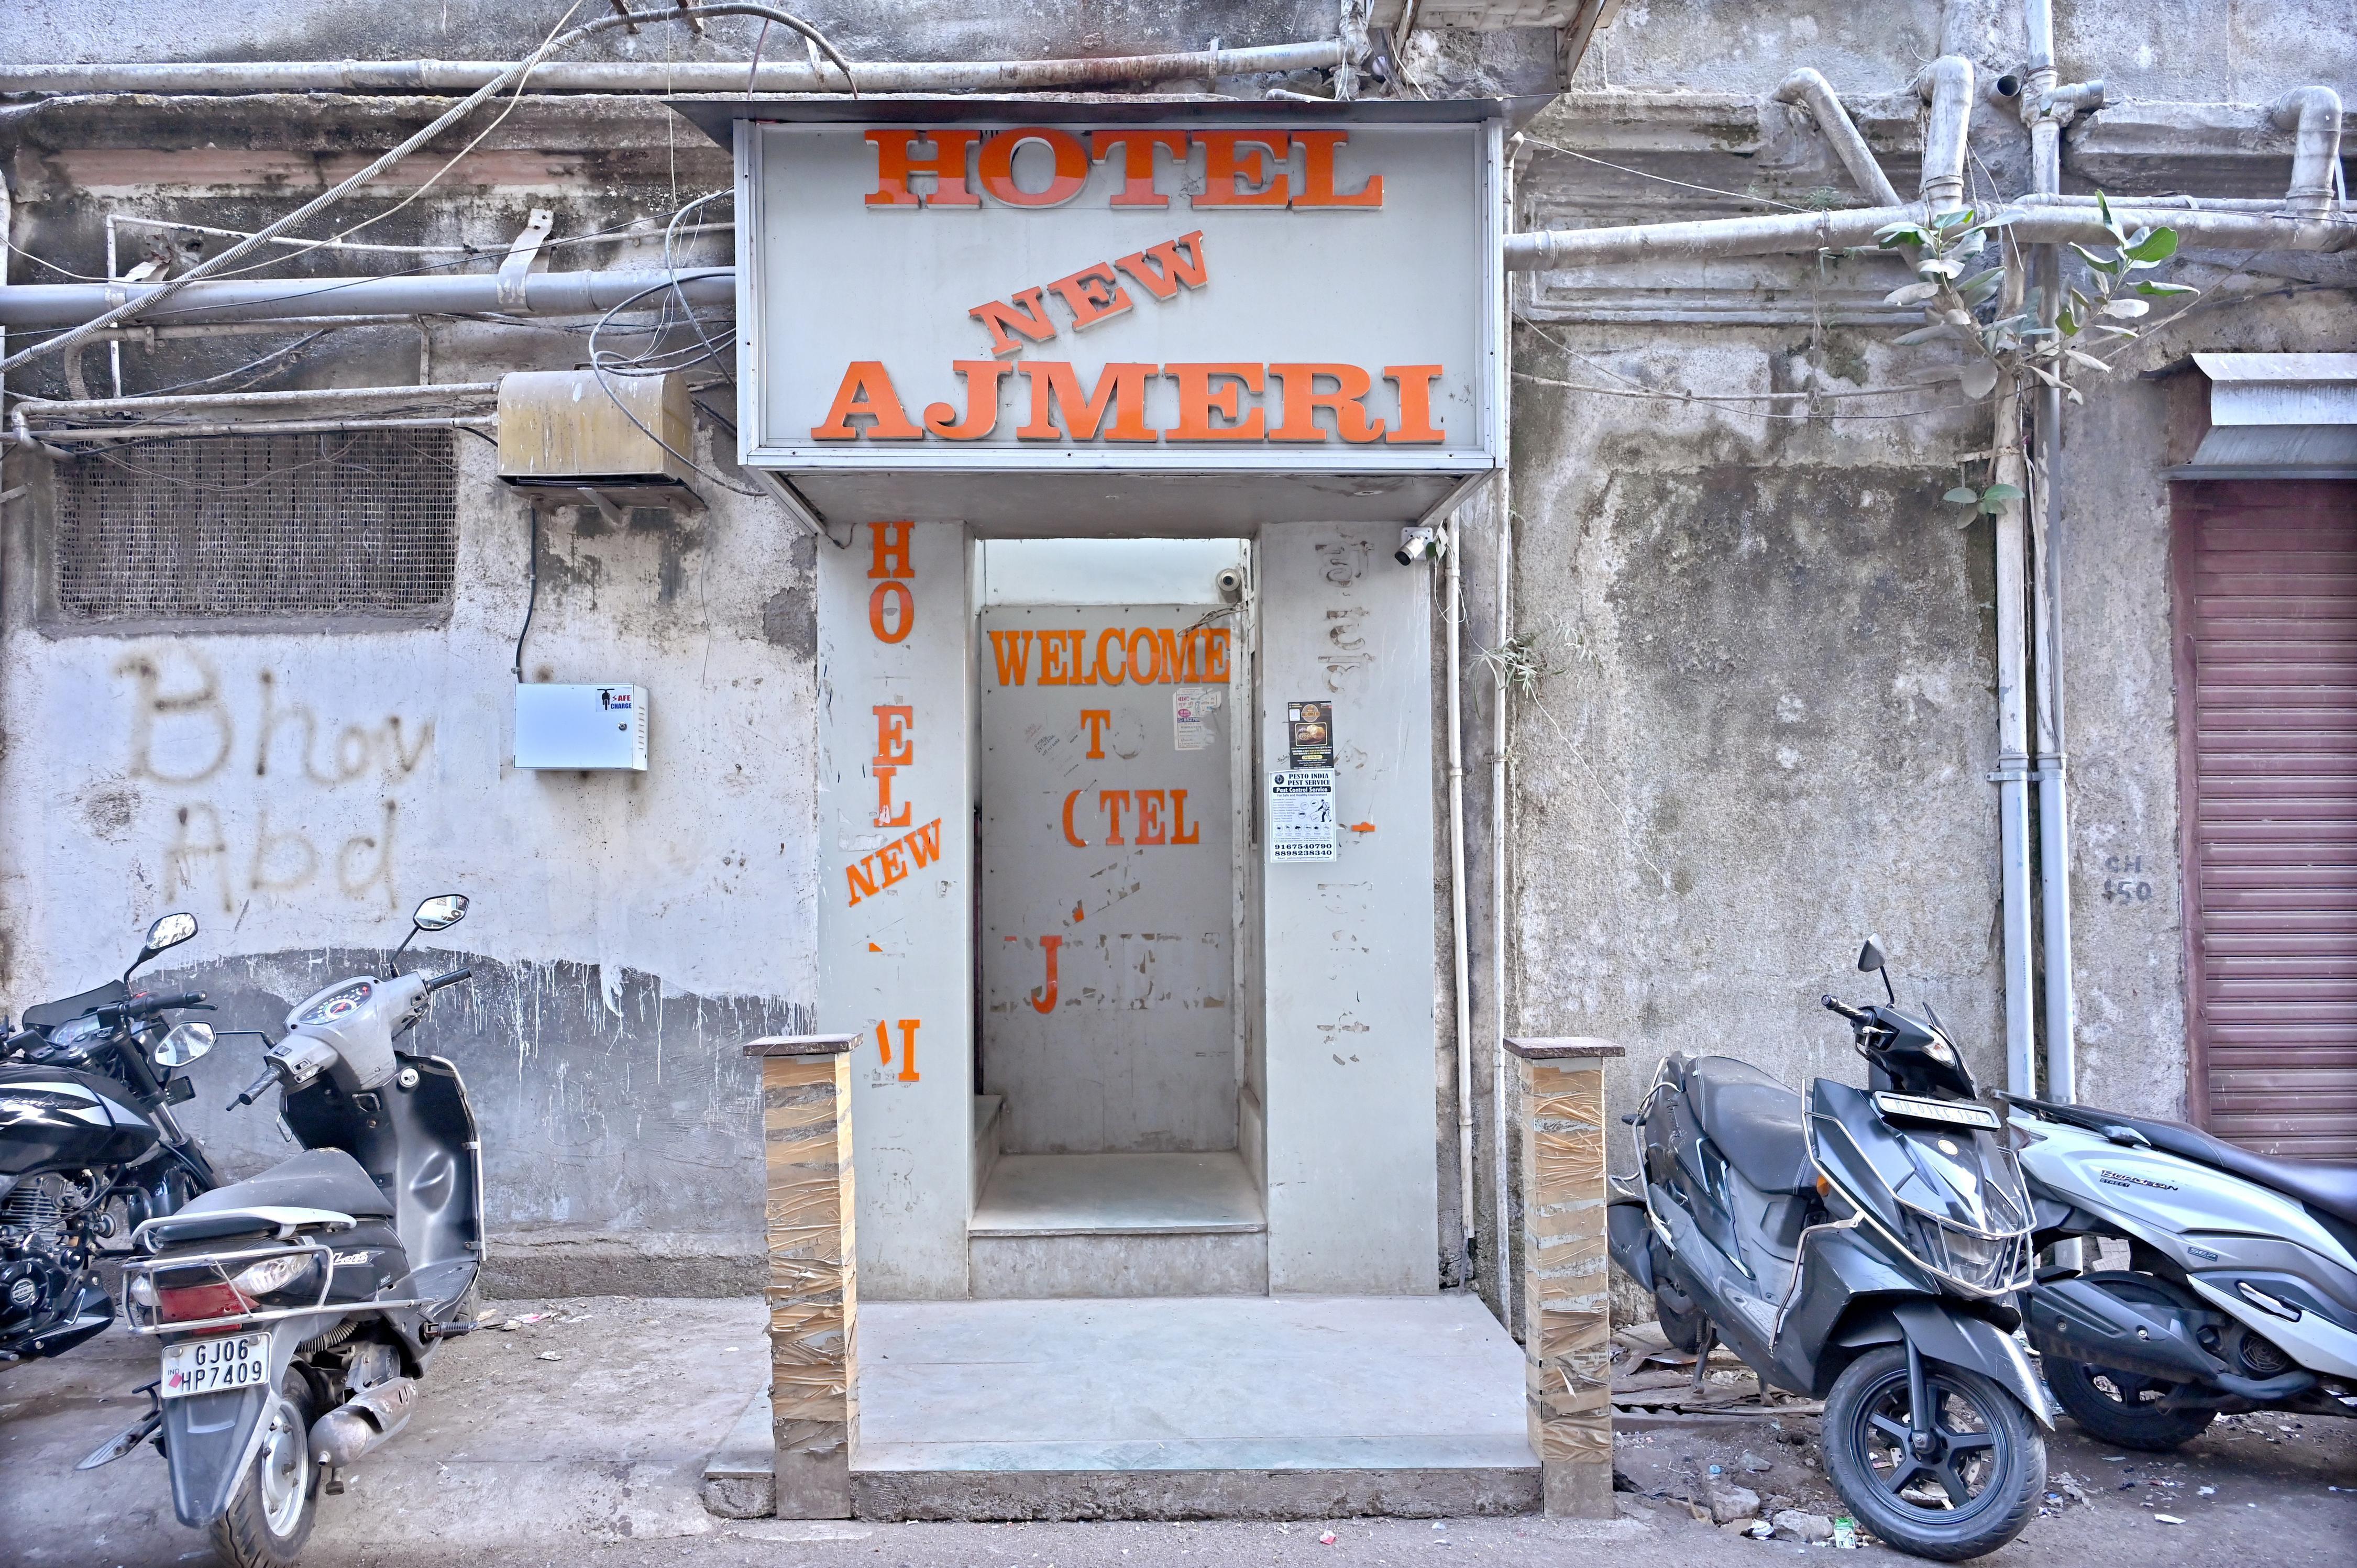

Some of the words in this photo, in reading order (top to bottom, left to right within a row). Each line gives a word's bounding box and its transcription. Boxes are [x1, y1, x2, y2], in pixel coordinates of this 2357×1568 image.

[864, 127, 1383, 209] HOTEL
[969, 230, 1208, 357] NEW
[811, 360, 1447, 444] AJMERI
[867, 522, 915, 826] HOEL
[989, 627, 1231, 686] WELCOME
[161, 798, 399, 912] Abd
[845, 817, 942, 907] NEW
[2100, 1170, 2179, 1191] BURGMAN
[2100, 1178, 2130, 1187] STREET
[2189, 1248, 2216, 1258] SEP
[181, 1360, 262, 1392] HP7409
[196, 1339, 248, 1366] GJ06
